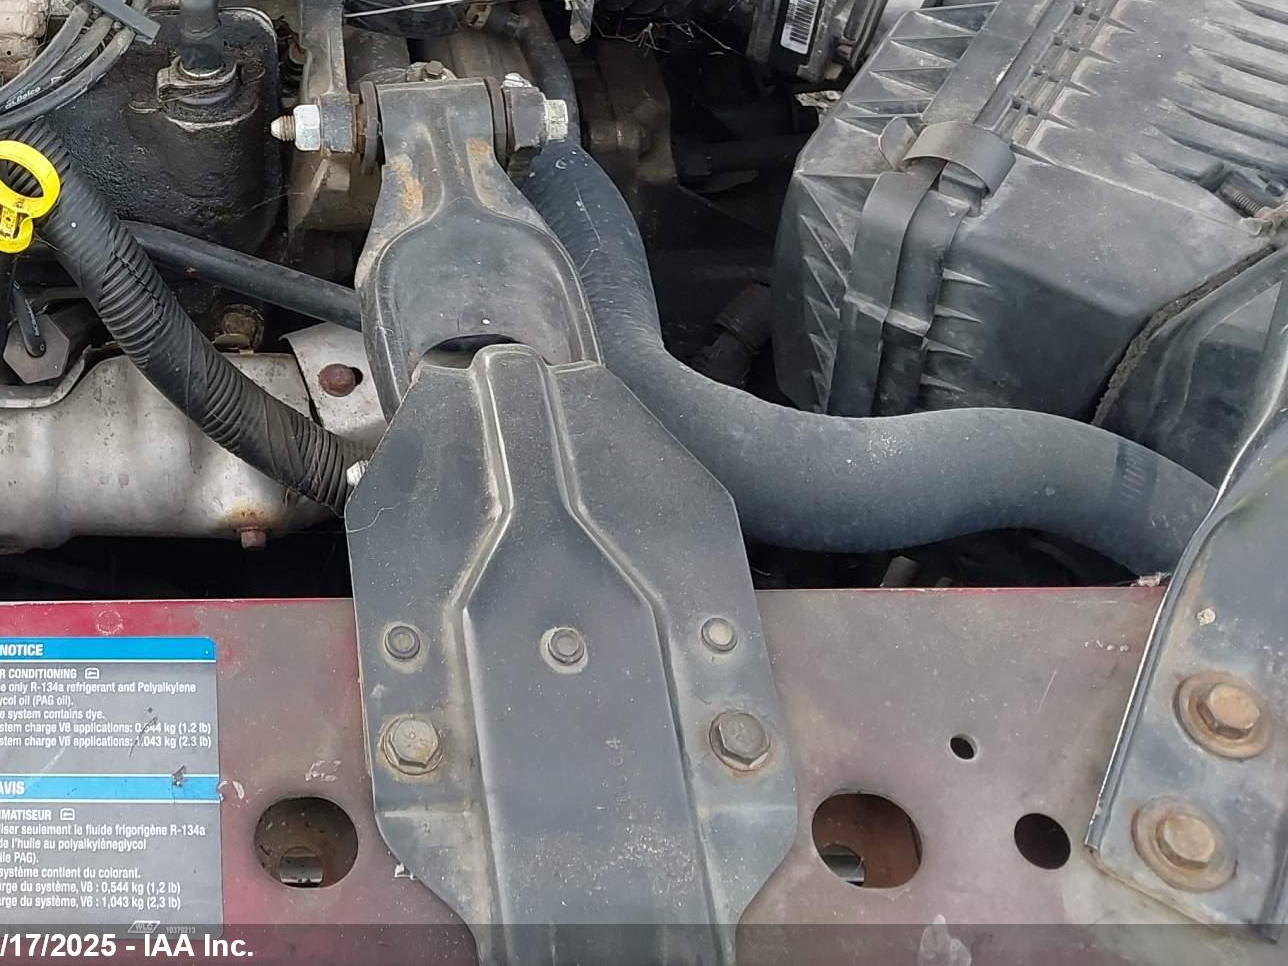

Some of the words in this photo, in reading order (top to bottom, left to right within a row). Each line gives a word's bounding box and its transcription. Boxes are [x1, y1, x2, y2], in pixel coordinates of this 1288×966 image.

[0, 644, 43, 656] NOTICE
[9, 669, 77, 679] CONDITIONING
[9, 683, 28, 694] only
[30, 683, 64, 692] R-134a
[66, 683, 115, 694] refrigerant
[118, 683, 135, 692] and
[138, 682, 196, 694] Polyalkylene
[19, 696, 30, 705] oil
[33, 696, 54, 707] (PAG
[56, 696, 74, 707] oil).
[8, 709, 41, 720] system
[43, 709, 83, 718] contains
[86, 709, 105, 720] dye.
[14, 852, 39, 863] PAG).
[41, 867, 80, 878] contient
[83, 867, 95, 878] du
[98, 868, 141, 879] colorant.
